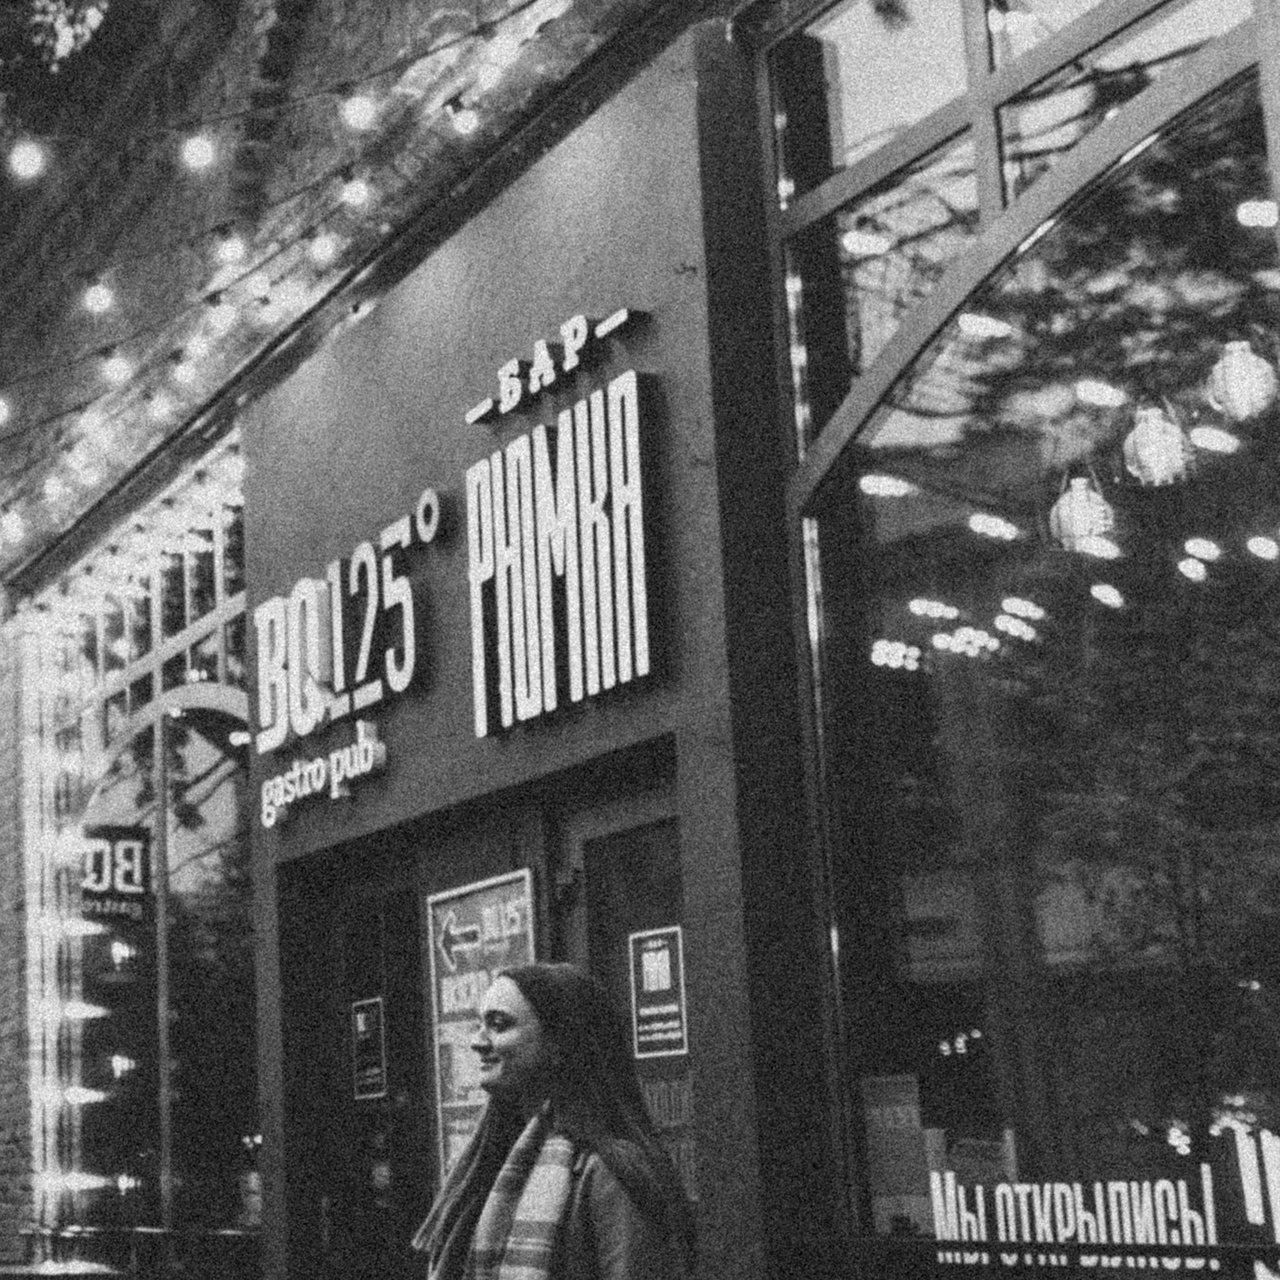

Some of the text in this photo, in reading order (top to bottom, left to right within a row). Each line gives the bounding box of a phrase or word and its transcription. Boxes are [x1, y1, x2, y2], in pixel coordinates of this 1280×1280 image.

[466, 369, 650, 738] РЮМКА
[261, 719, 376, 828] gastro pub
